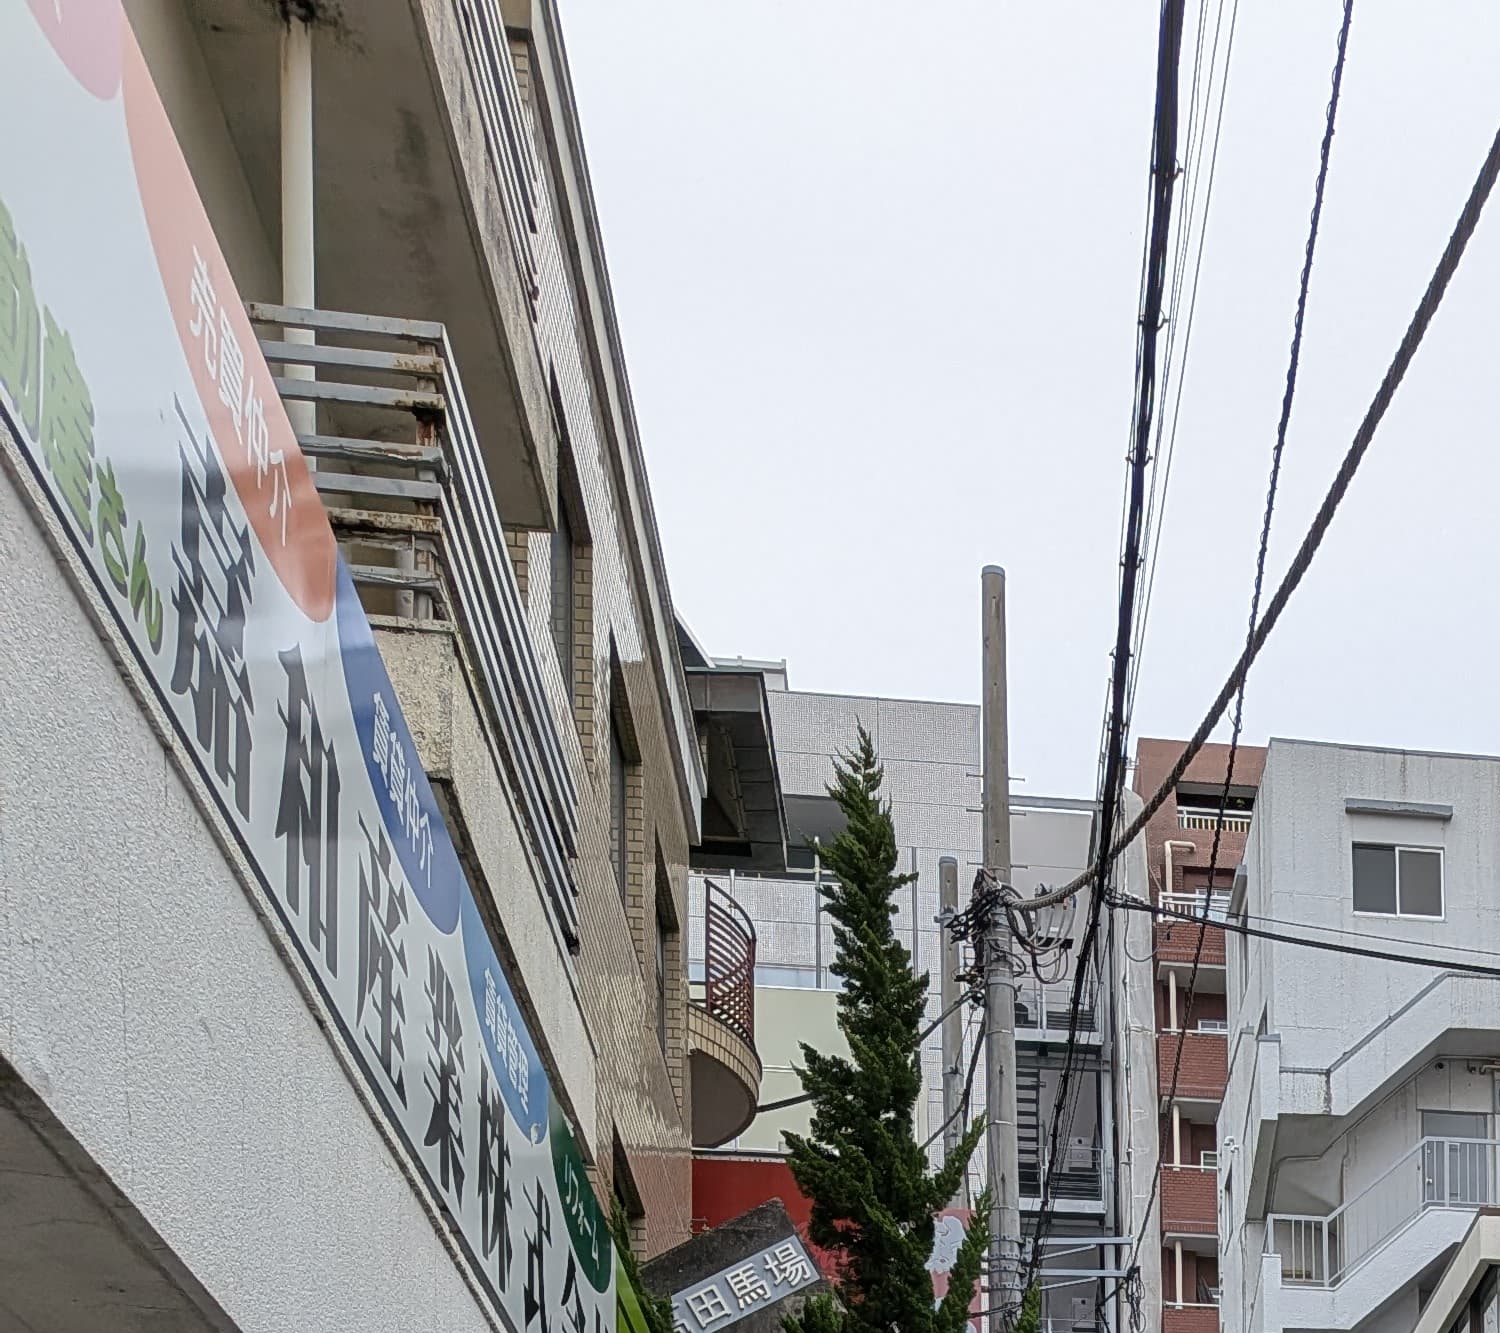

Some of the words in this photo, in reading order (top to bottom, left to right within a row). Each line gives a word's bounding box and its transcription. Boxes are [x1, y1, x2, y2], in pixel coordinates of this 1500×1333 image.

[190, 245, 294, 546] 売買仲介
[373, 691, 435, 889] 賃貸仲介
[484, 966, 530, 1115] 賃貸管理
[564, 1153, 600, 1271] リフォーム
